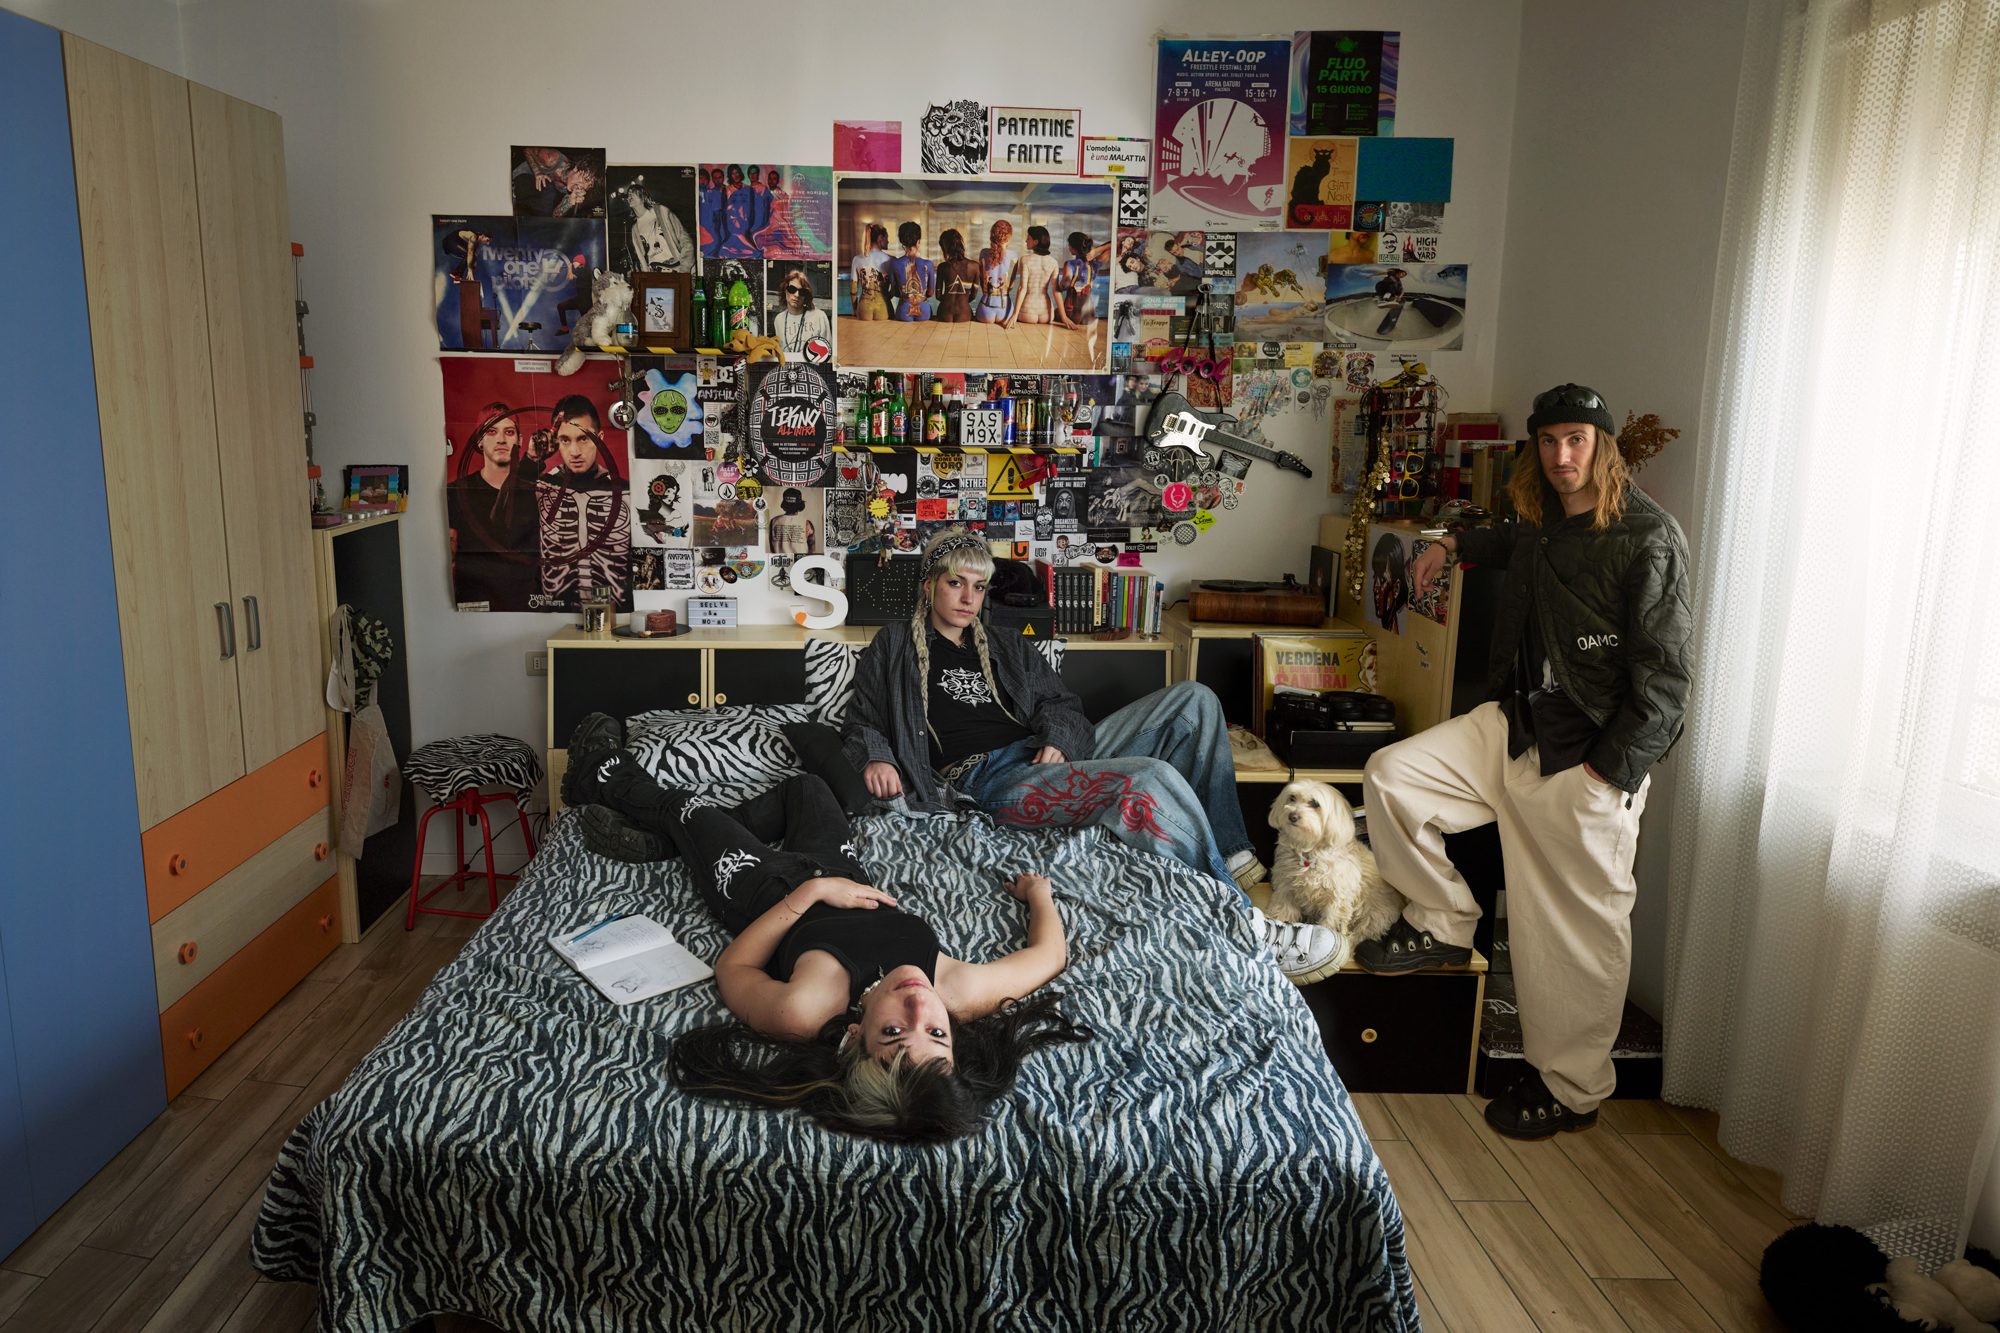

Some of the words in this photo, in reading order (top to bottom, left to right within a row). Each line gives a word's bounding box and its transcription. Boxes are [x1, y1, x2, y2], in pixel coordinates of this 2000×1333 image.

[1182, 49, 1267, 63] ALLEY-OOP
[1327, 58, 1367, 70] FLUO
[1318, 69, 1372, 82] PARTY
[1316, 85, 1328, 95] 15
[1329, 84, 1373, 95] GIUGNO
[998, 117, 1075, 138] PATATINE
[1007, 144, 1063, 164] FRITTE
[1109, 154, 1146, 162] MALATTIA
[1327, 190, 1352, 202] NOIR
[1416, 237, 1438, 246] HIGH
[481, 245, 545, 262] Twenty
[1416, 252, 1436, 260] YARD
[504, 261, 540, 275] one
[491, 274, 541, 290] pilots
[767, 404, 822, 429] TEKNO
[934, 461, 963, 470] TORO
[960, 478, 987, 488] NETHER
[787, 556, 848, 630] S
[1577, 634, 1618, 651] OAMC
[1276, 651, 1340, 666] VERDENA
[1275, 673, 1347, 689] SAMURAI
